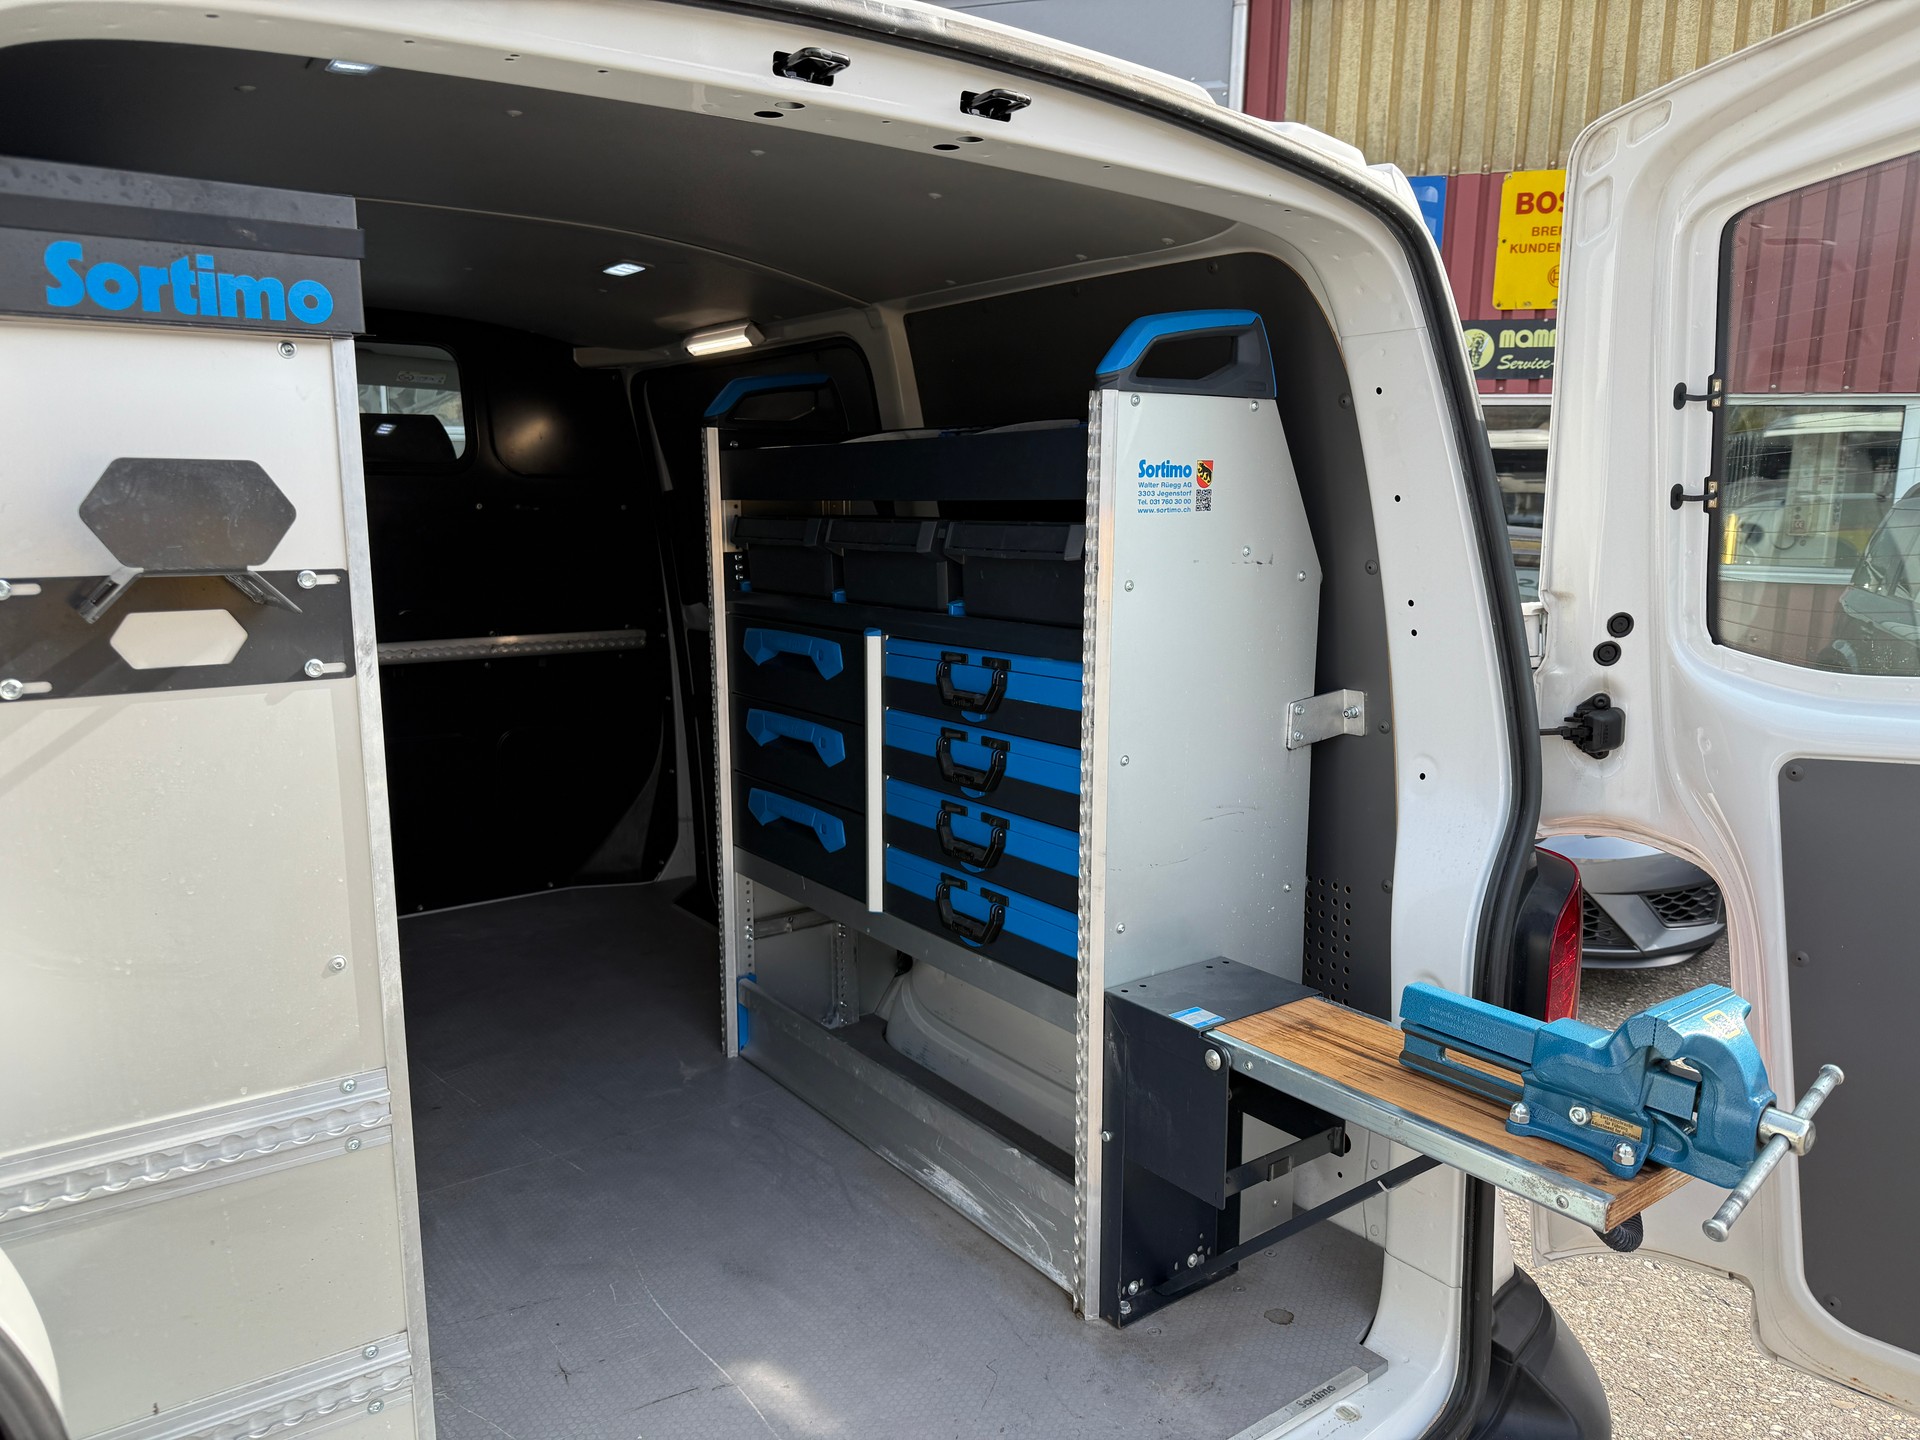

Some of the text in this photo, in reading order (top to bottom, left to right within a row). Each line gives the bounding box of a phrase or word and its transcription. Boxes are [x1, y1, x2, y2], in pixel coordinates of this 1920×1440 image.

[1531, 226, 1562, 237] BRE
[44, 240, 333, 325] Sortimo
[1138, 459, 1192, 478] Sortimo
[1157, 490, 1192, 498] Jegenstorf
[1296, 1385, 1336, 1408] Sortimo
